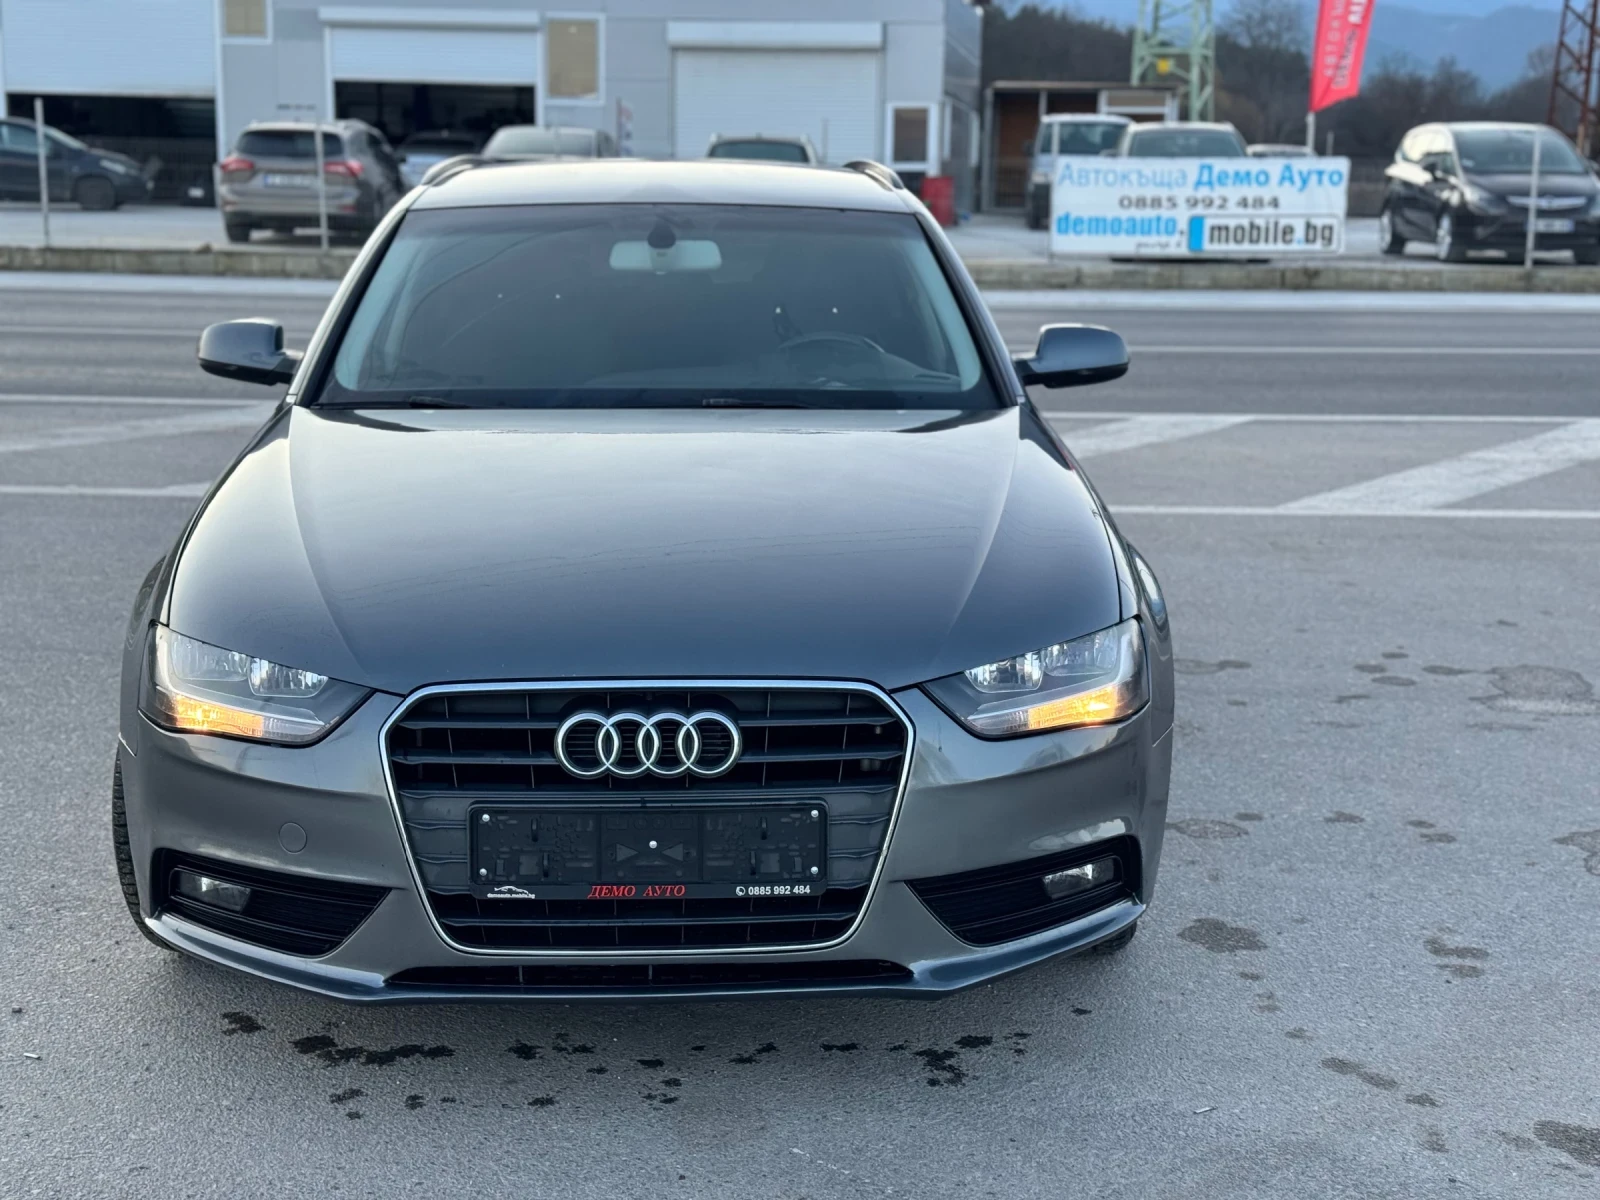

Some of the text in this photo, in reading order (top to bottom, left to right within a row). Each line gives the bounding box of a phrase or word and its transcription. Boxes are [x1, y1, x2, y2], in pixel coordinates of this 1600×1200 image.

[1058, 163, 1344, 192] Автокъща Демо Ауто
[1118, 195, 1280, 210] 0885 992 484
[1209, 219, 1334, 247] mobile.bg
[587, 884, 686, 899] ДЕМО АУТО
[748, 884, 811, 895] 0885 992 484
